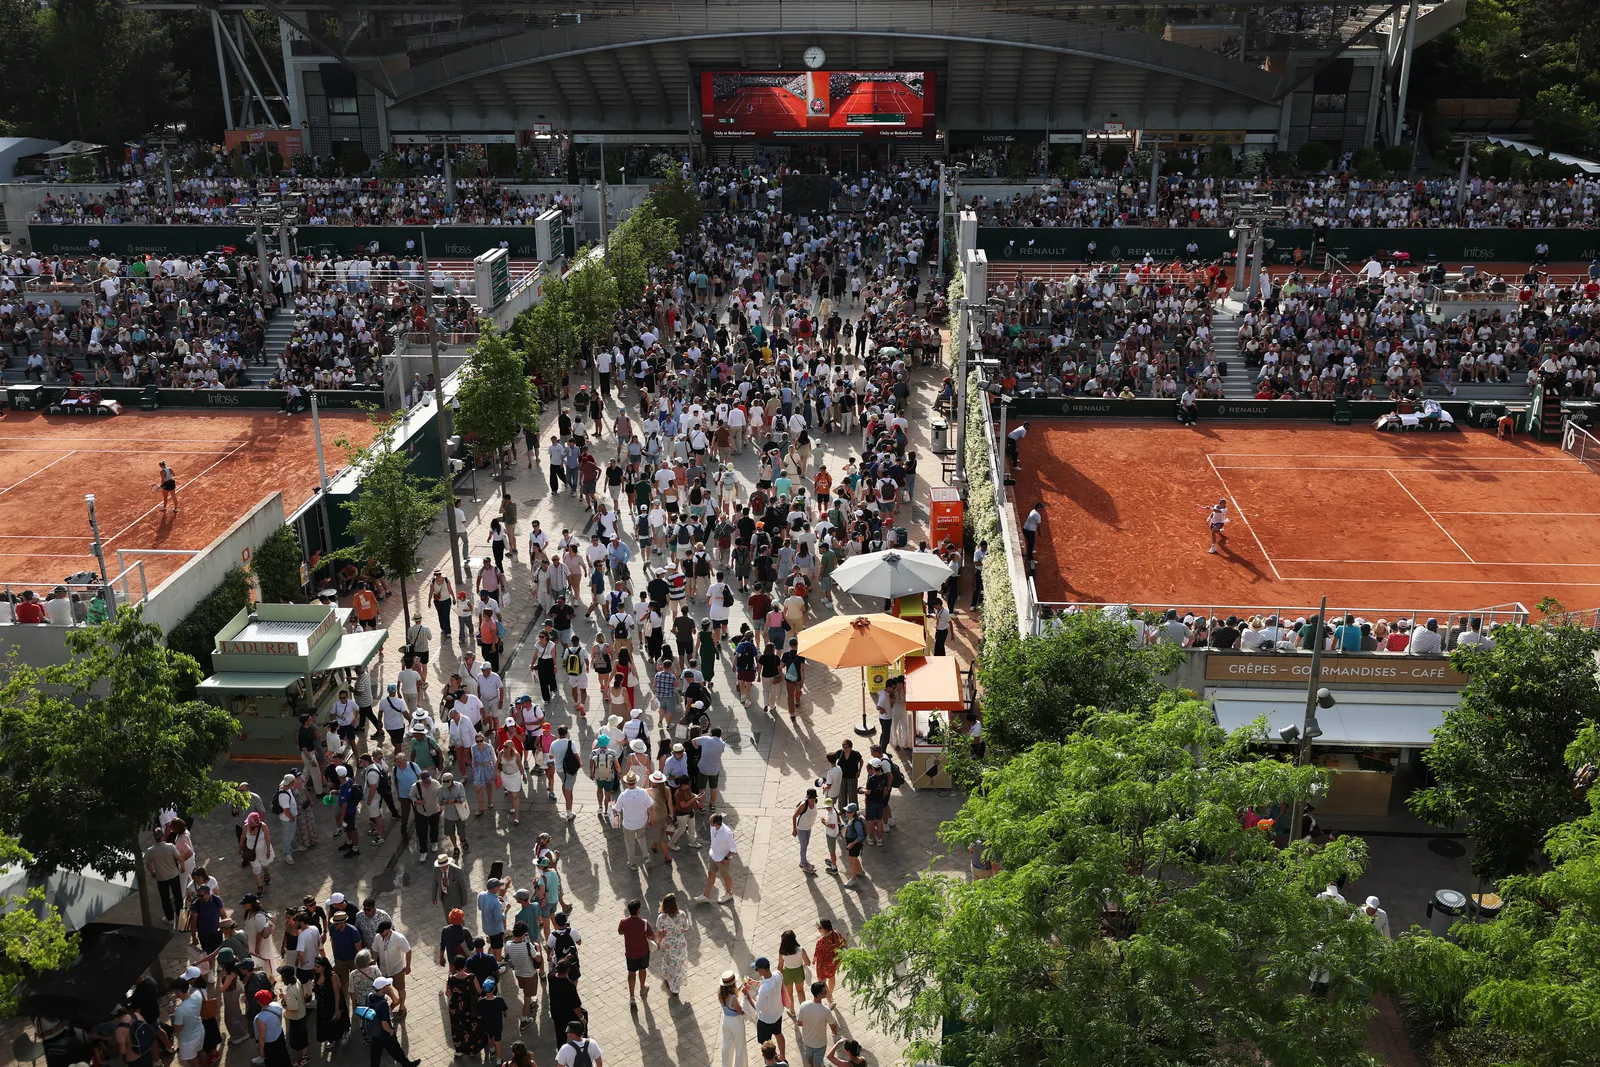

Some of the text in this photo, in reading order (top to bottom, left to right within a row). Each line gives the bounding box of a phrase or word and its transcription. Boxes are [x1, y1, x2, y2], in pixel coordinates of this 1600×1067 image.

[445, 243, 472, 255] Infosys
[1019, 247, 1067, 256] RENAULT
[1127, 248, 1176, 256] RENAULT
[1463, 246, 1495, 259] Infosys
[208, 393, 239, 406] Infosys
[221, 641, 297, 654] LADURÉE
[1229, 662, 1277, 674] CRÊPES
[1291, 665, 1397, 677] GORMANDISES
[1411, 666, 1445, 678] CAFÉ
